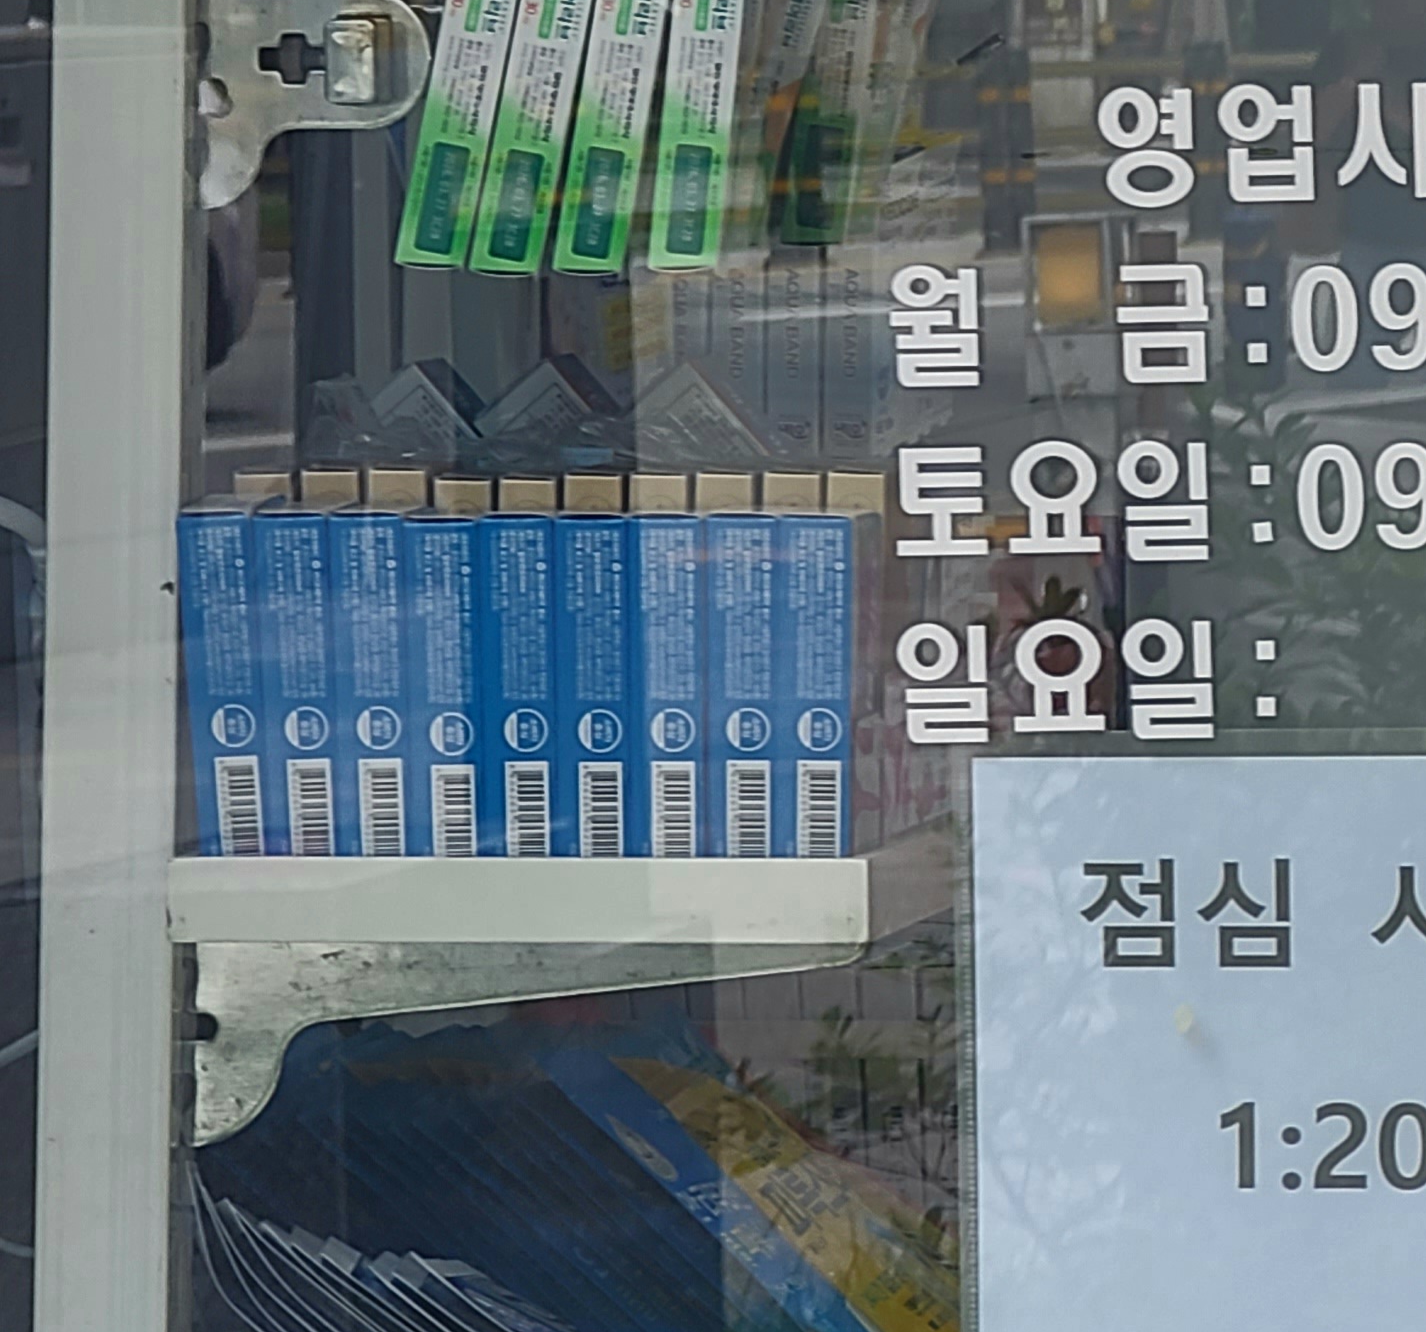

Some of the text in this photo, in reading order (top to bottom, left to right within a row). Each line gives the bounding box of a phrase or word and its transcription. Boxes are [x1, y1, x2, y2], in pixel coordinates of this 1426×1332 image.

[889, 264, 980, 387] 월
[896, 617, 1279, 744] 일요일:
[1079, 856, 1295, 971] 점심
